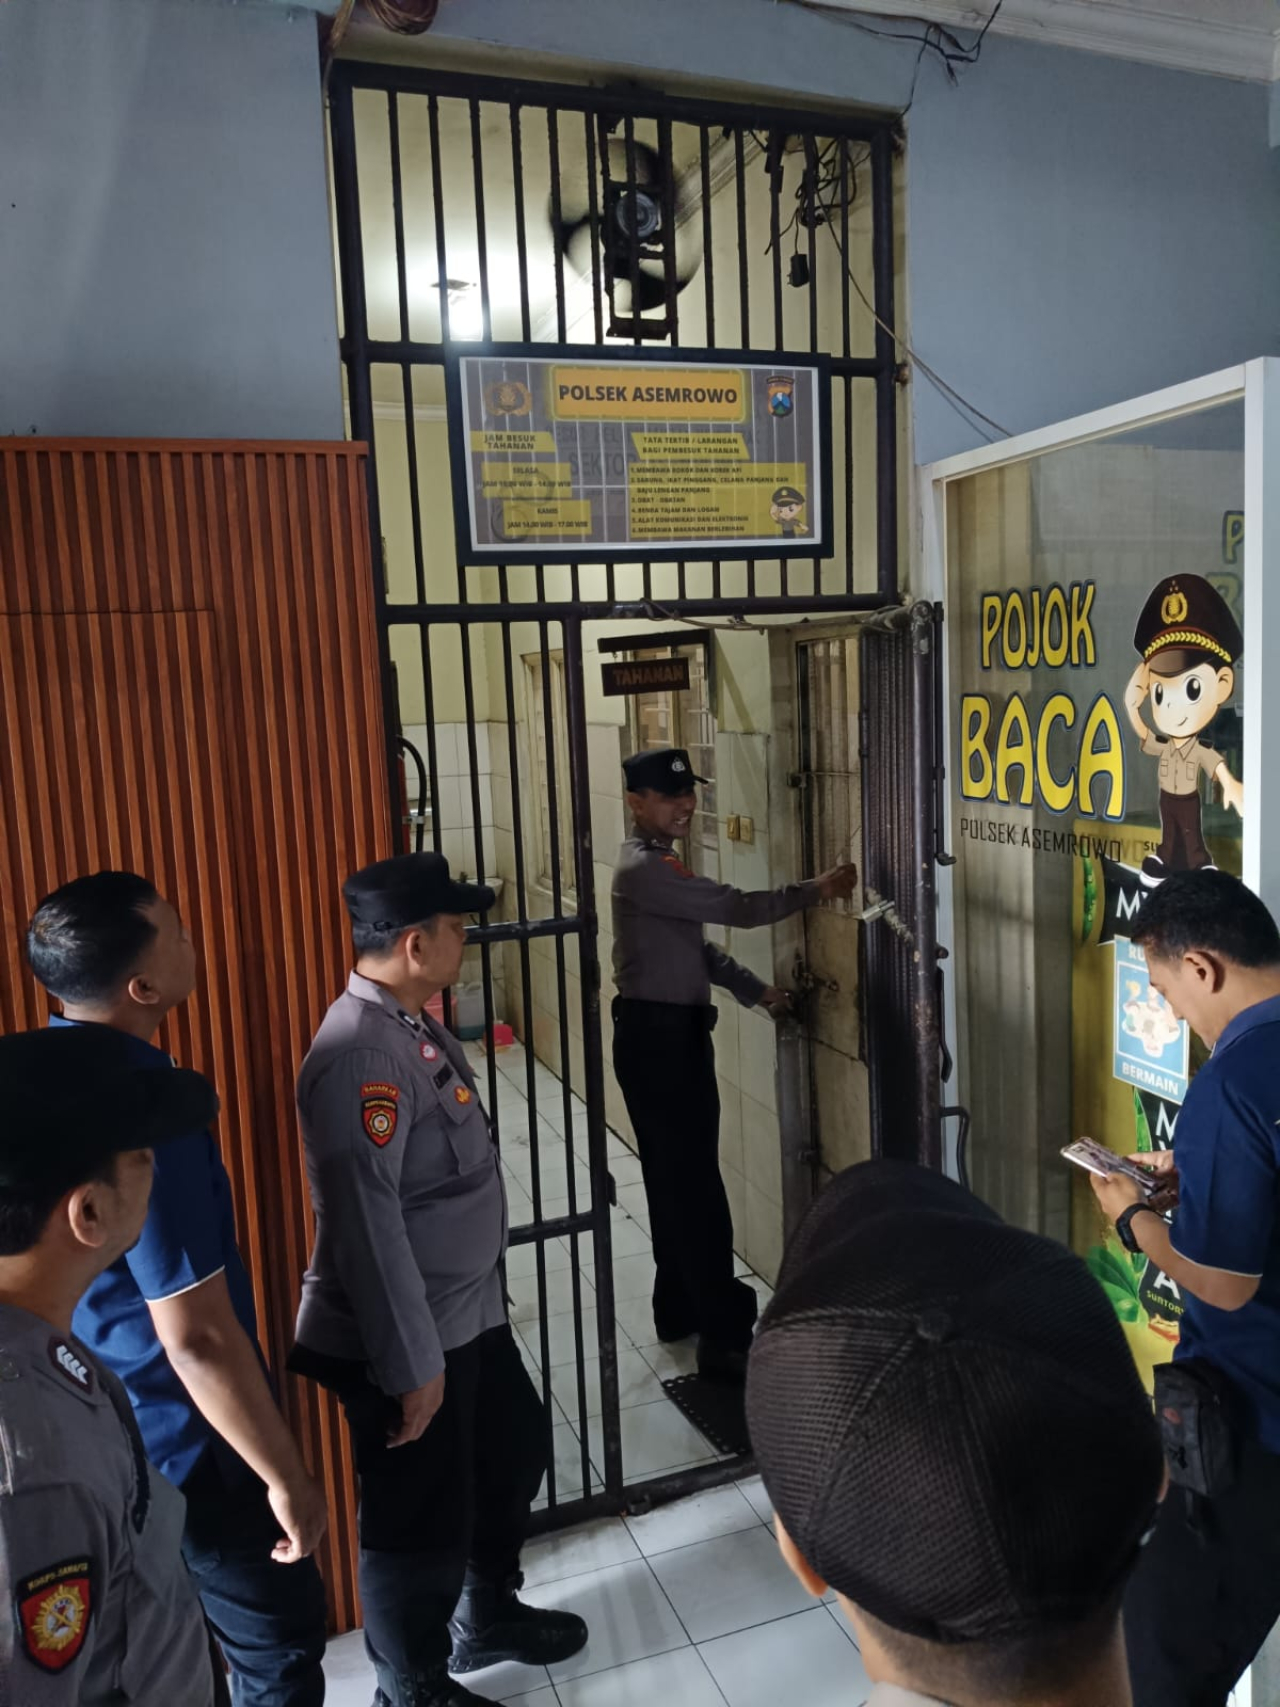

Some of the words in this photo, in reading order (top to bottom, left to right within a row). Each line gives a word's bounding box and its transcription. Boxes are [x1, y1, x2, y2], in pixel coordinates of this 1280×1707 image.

[558, 384, 628, 402] POLSEK
[632, 386, 738, 404] ASEMROWO
[484, 434, 503, 443] JAM
[506, 434, 536, 443] BESUK
[487, 442, 535, 450] TAHANAN
[643, 436, 663, 444] TATA
[665, 436, 690, 444] TERTIB
[697, 437, 738, 445] LARANGAN
[642, 446, 661, 454] BAGI
[662, 446, 701, 454] PEMBESUK
[703, 446, 740, 454] TAHANAN
[694, 466, 709, 475] DAN
[981, 579, 1096, 670] POJOK
[612, 664, 684, 687] TAHANAN
[959, 690, 1127, 823] BACA
[960, 818, 1017, 845] POLSEK
[1021, 826, 1122, 863] ASEMROWO
[1121, 1060, 1179, 1096] BERMAIN
